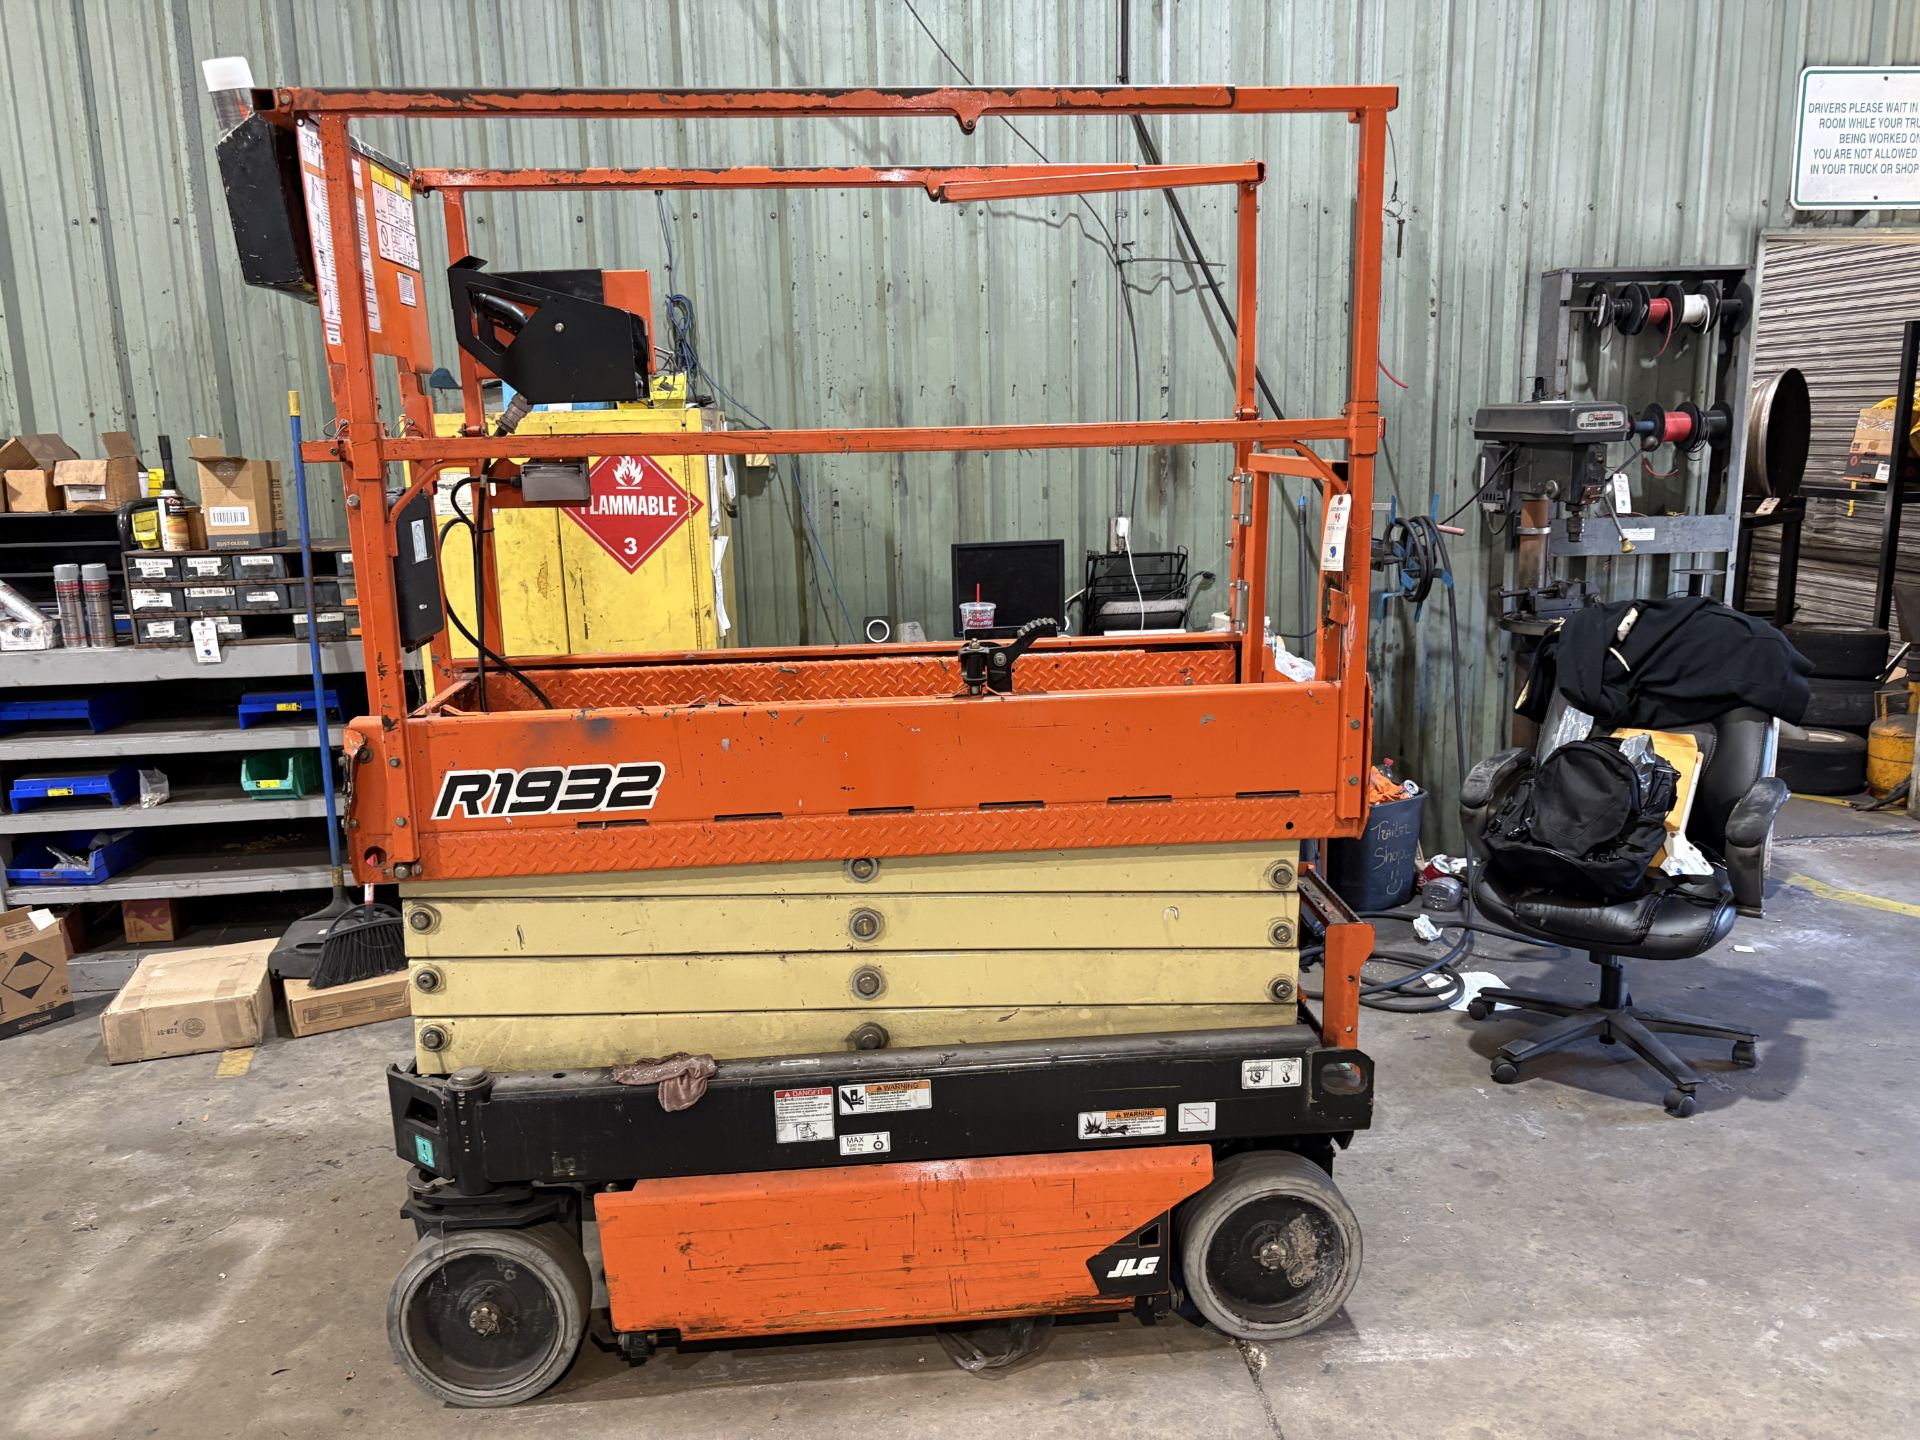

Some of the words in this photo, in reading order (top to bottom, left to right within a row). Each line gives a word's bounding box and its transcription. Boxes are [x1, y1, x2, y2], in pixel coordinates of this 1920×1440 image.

[1808, 102, 1847, 113] DRIVERS
[1849, 102, 1884, 113] PLEASE
[1886, 102, 1908, 113] WAIT
[1909, 102, 1919, 113] IN
[1819, 118, 1846, 129] ROOM
[1848, 118, 1876, 129] WHILE
[1879, 117, 1903, 128] YOUR
[1839, 133, 1866, 144] BEING
[1868, 133, 1907, 144] WORKED
[1813, 149, 1831, 159] YOU
[1833, 149, 1852, 159] ARE
[1854, 149, 1872, 159] NOT
[1874, 148, 1918, 159] ALLOWED
[1810, 164, 1819, 174] IN
[1822, 164, 1846, 174] YOUR
[1849, 164, 1878, 174] TRUCK
[1880, 164, 1893, 174] OR
[1895, 164, 1919, 174] SHOP
[623, 537, 637, 555] 3
[433, 764, 664, 819] R1932
[883, 1082, 919, 1091] WARNING
[1123, 1110, 1155, 1118] WARNING
[846, 1136, 864, 1144] MAX
[1106, 1256, 1160, 1278] JLG
